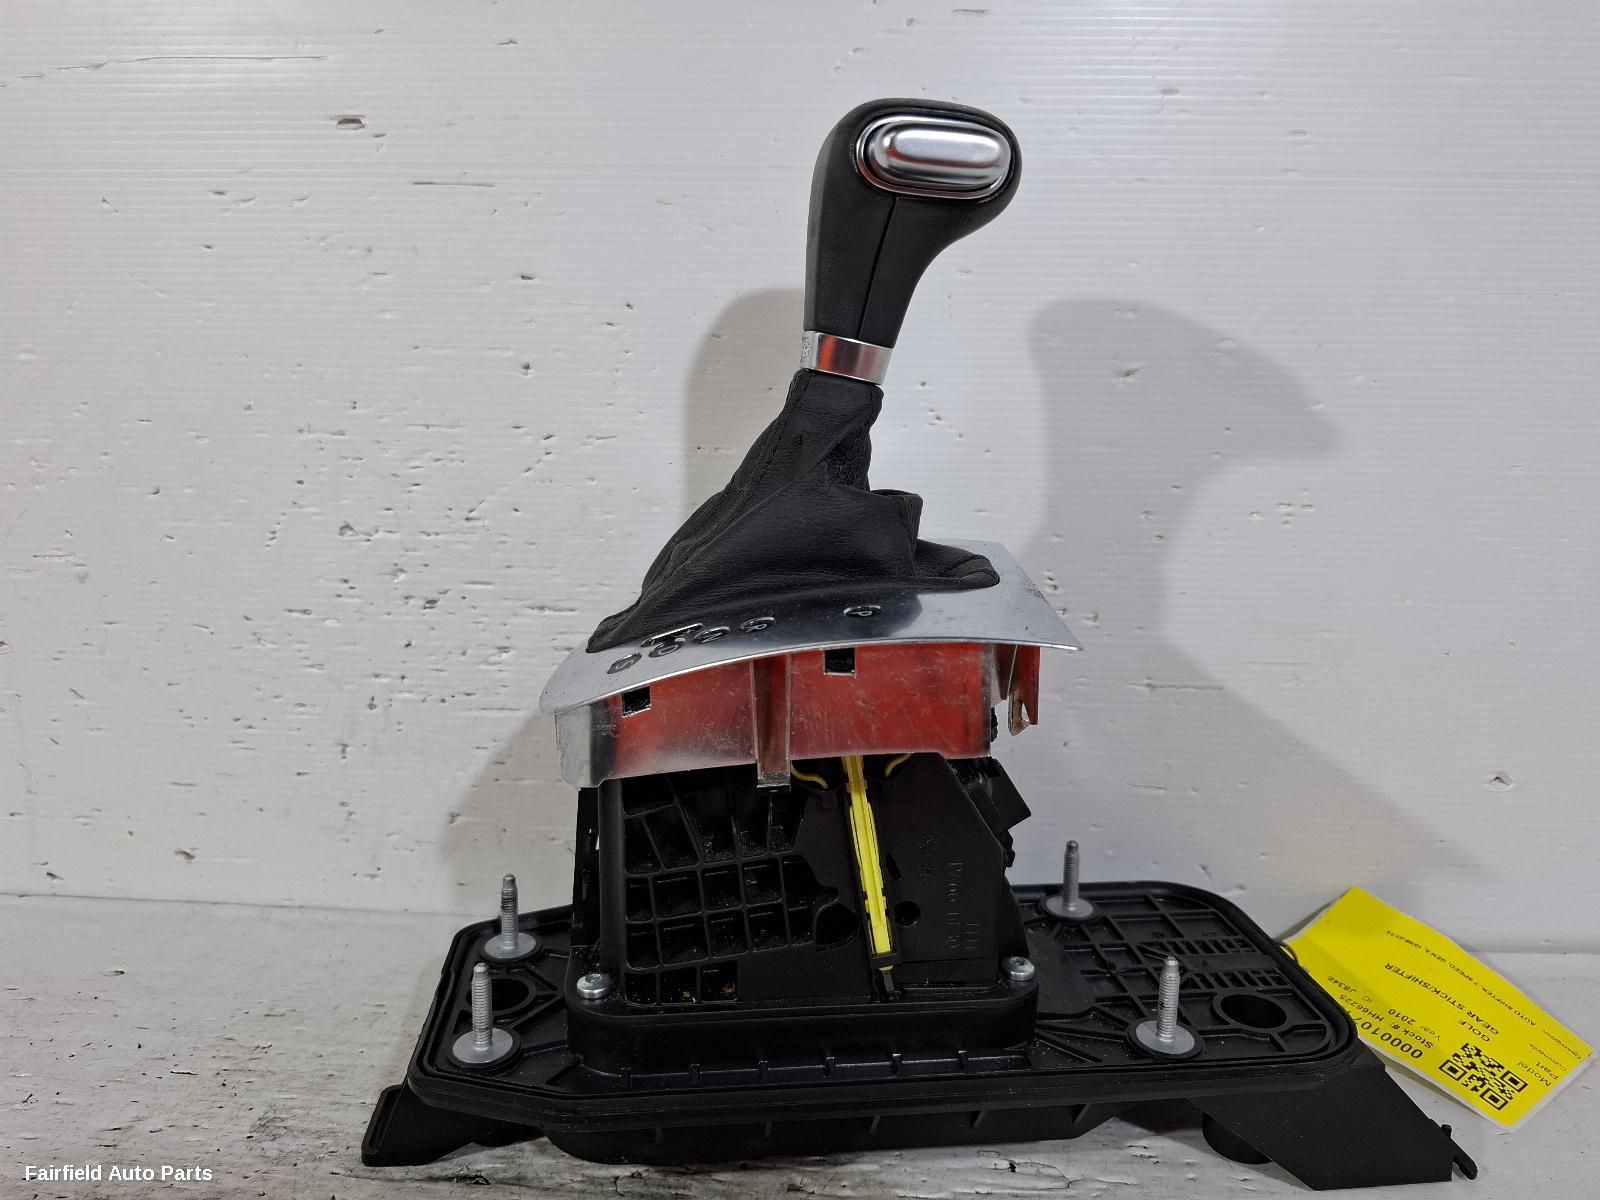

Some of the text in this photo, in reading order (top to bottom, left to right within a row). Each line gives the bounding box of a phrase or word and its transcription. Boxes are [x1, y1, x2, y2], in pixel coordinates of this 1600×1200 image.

[1384, 963, 1560, 1080] Part GEAR STICK/SHIFTER
[1388, 1008, 1416, 1026] 2010
[1513, 1009, 1536, 1026] AUTO
[1403, 1028, 1434, 1049] Stock
[1420, 1025, 1440, 1042] Year
[1457, 1019, 1552, 1087] Model GOLF
